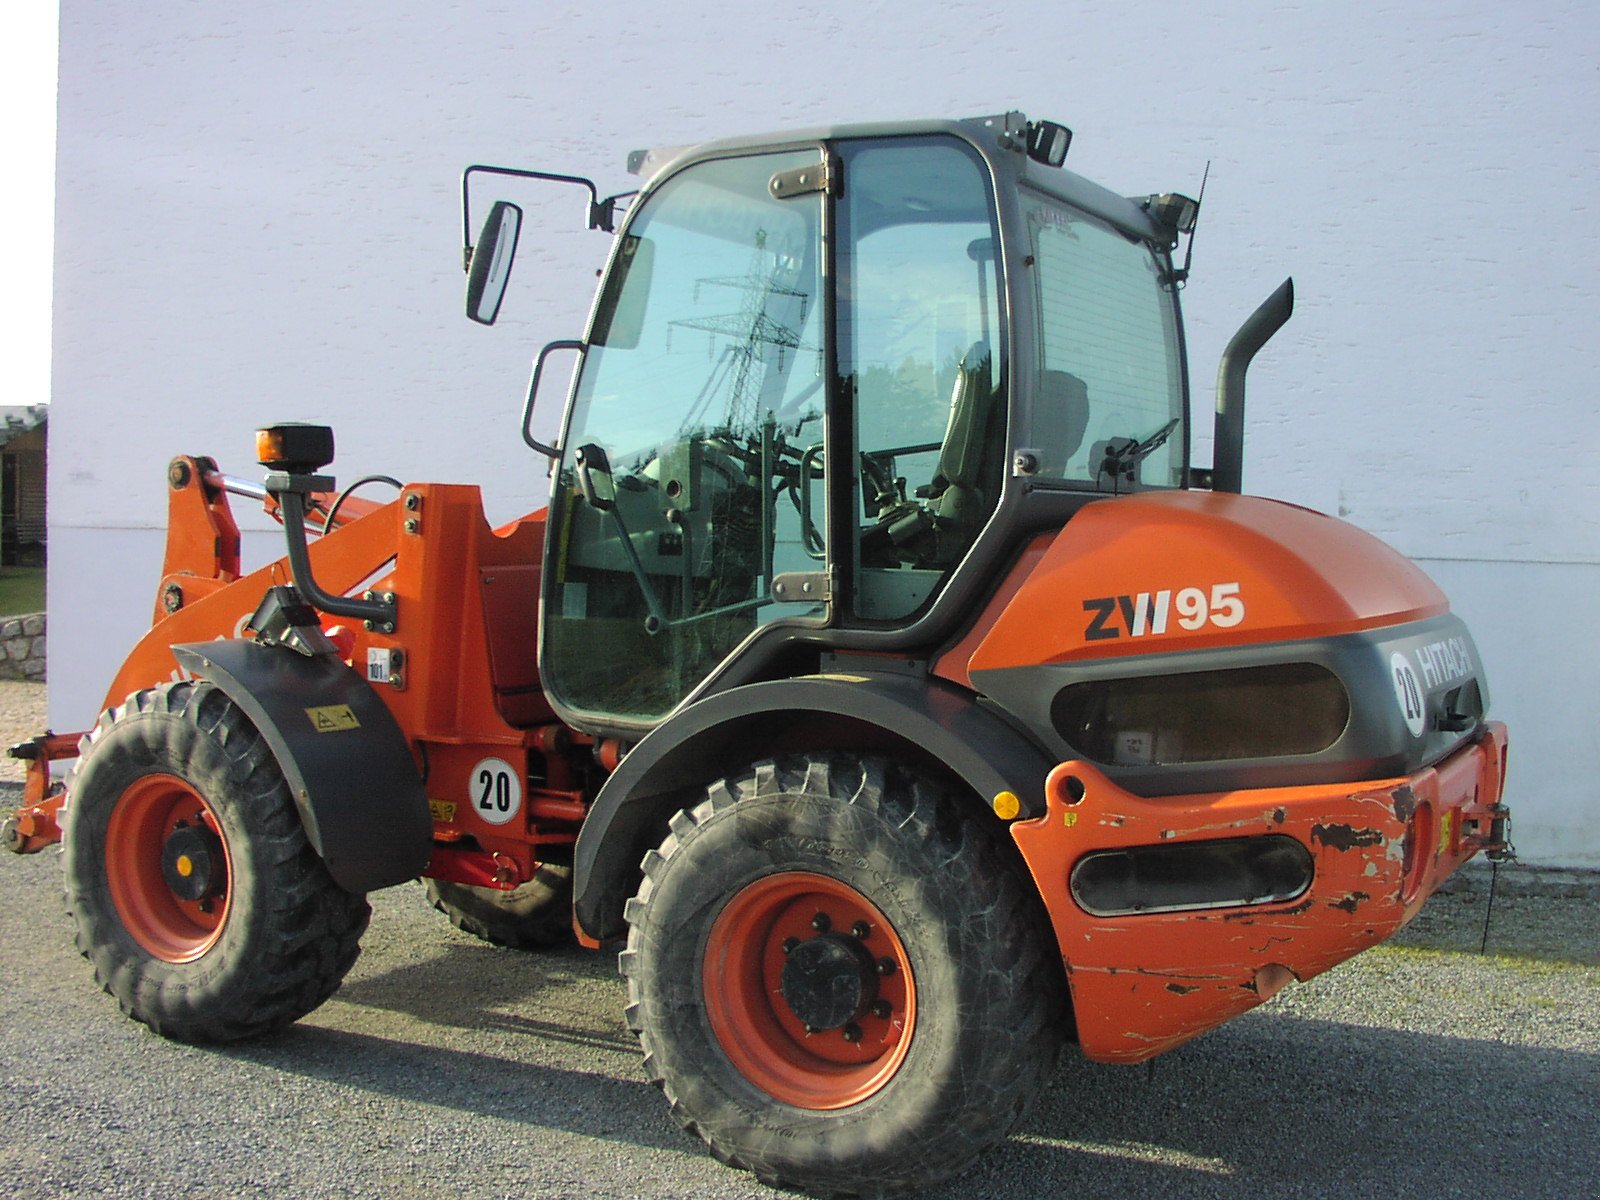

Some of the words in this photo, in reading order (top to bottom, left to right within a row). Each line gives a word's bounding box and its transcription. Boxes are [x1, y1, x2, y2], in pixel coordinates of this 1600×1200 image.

[1415, 636, 1473, 689] HITACHI
[1395, 666, 1420, 720] 20
[479, 769, 510, 812] 20
